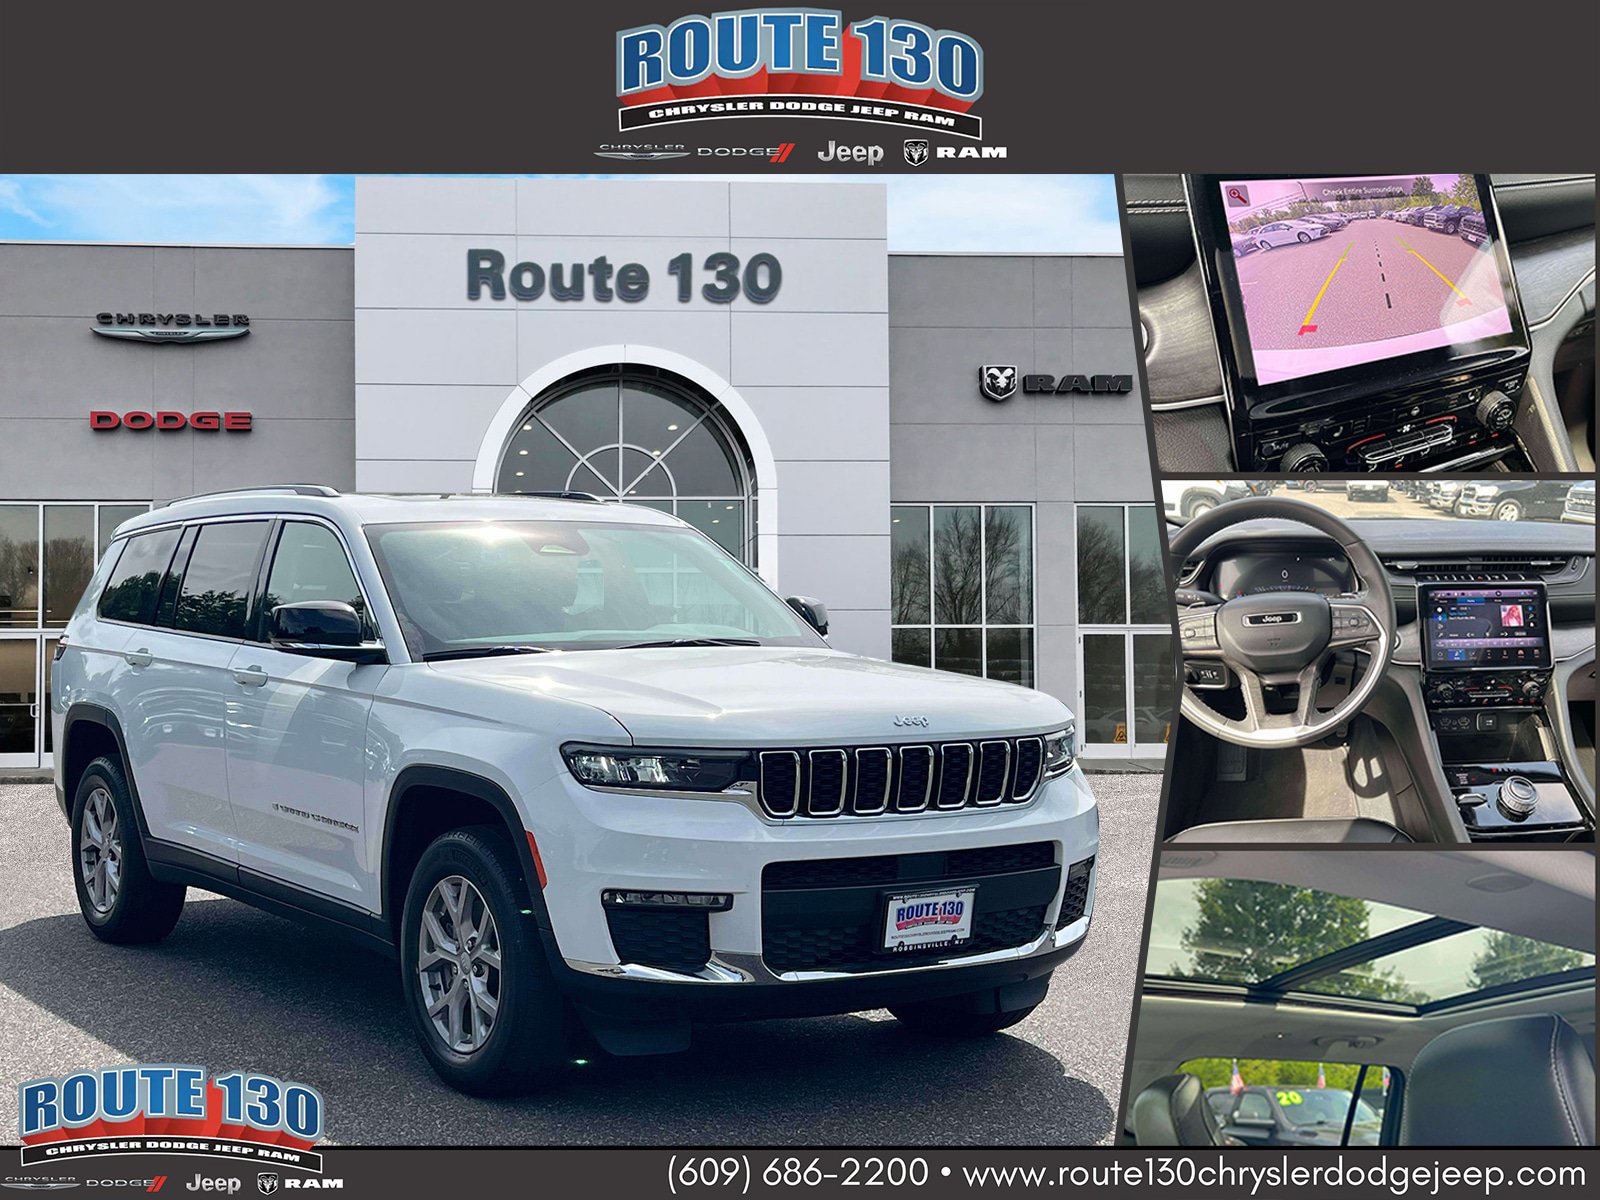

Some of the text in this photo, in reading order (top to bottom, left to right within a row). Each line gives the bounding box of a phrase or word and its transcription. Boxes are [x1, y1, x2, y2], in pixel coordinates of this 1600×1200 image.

[1322, 188, 1344, 196] Check
[467, 248, 783, 304] Route 130
[95, 312, 250, 326] CHRYSLER
[1022, 374, 1133, 394] RAM
[89, 410, 253, 432] DODGE
[893, 714, 929, 727] Jeep
[897, 901, 964, 922] ROUTE 130
[1276, 1091, 1303, 1106] 20
